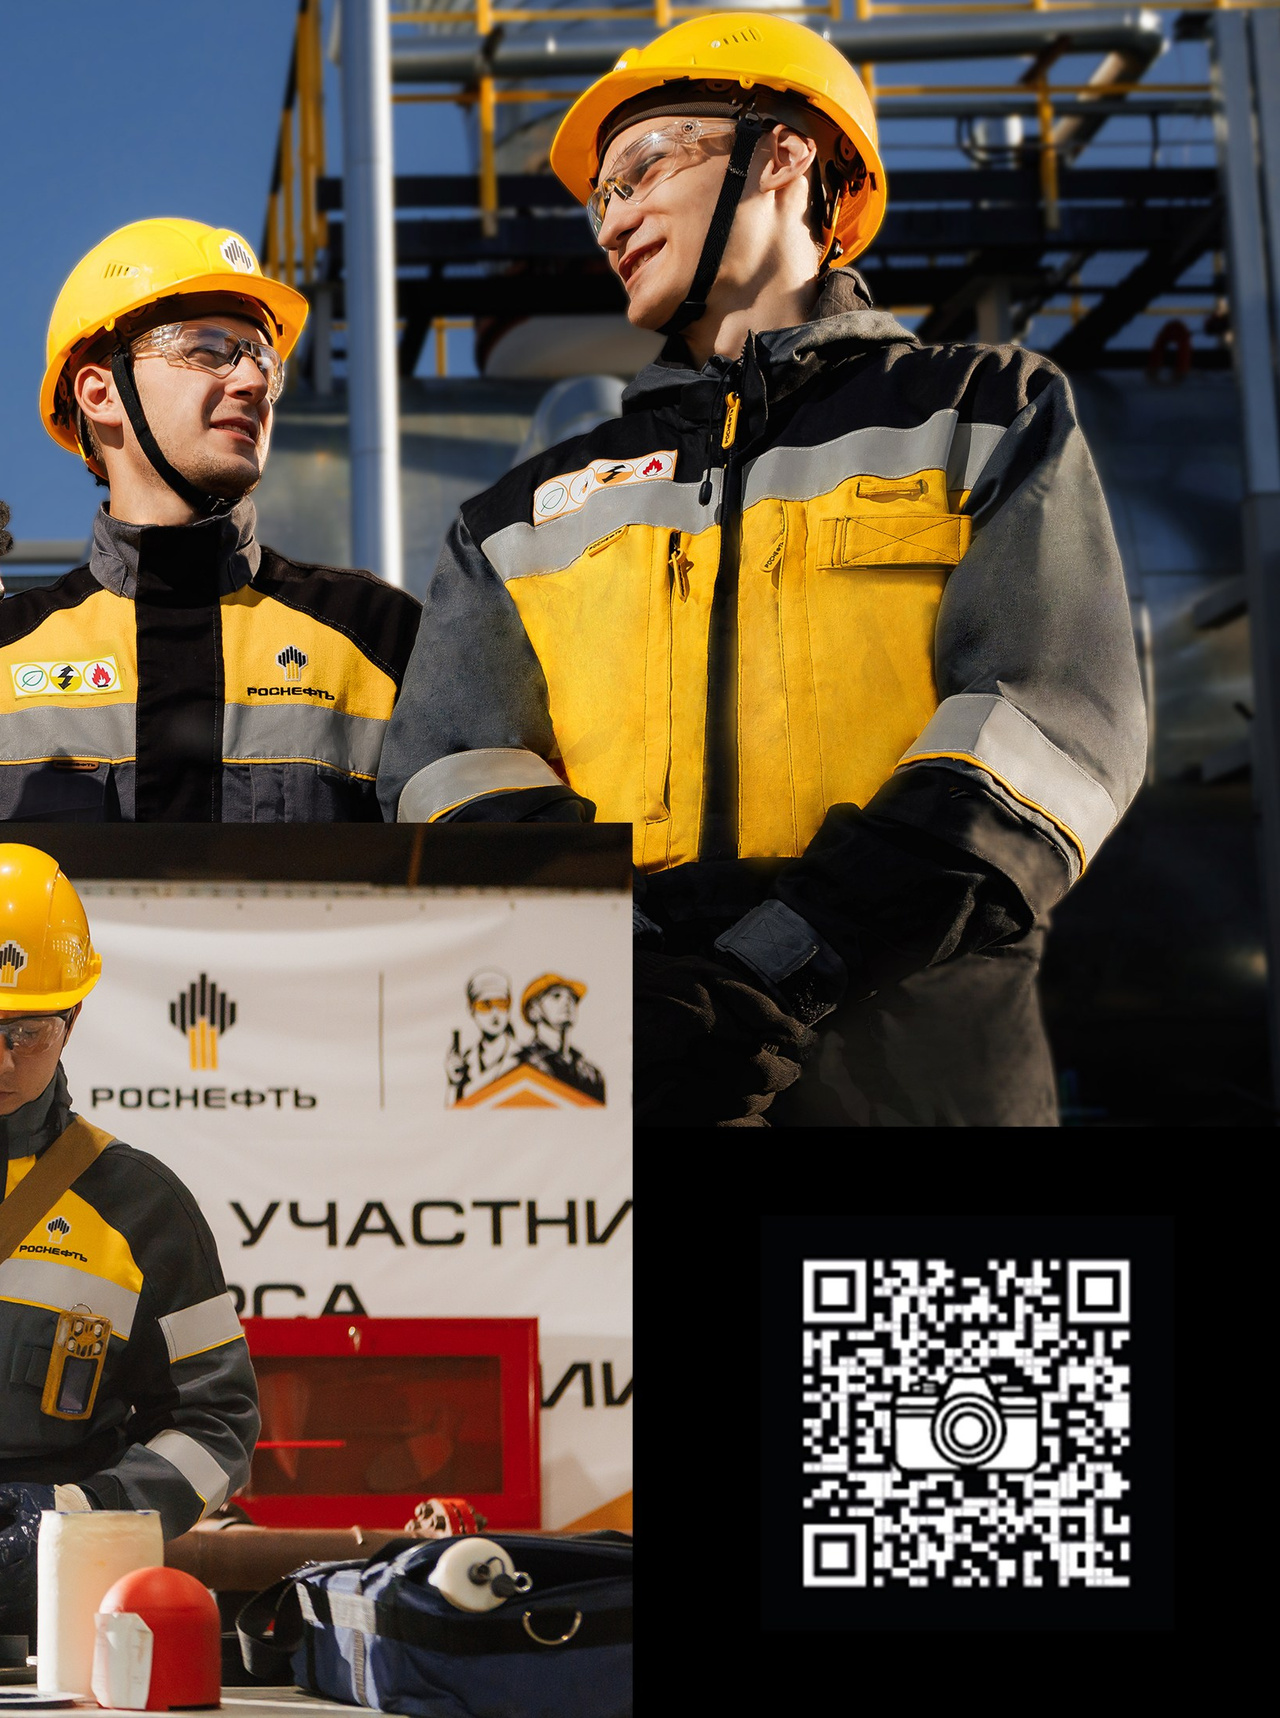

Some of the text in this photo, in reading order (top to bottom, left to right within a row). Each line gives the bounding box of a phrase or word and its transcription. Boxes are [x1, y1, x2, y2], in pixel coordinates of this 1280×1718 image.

[246, 686, 335, 701] РОСНЕФТЬ
[91, 1087, 318, 1109] РОСНЕФТЬ
[230, 1200, 633, 1247] УЧАСТНИ
[19, 1244, 88, 1263] РОСНЕФТЬ
